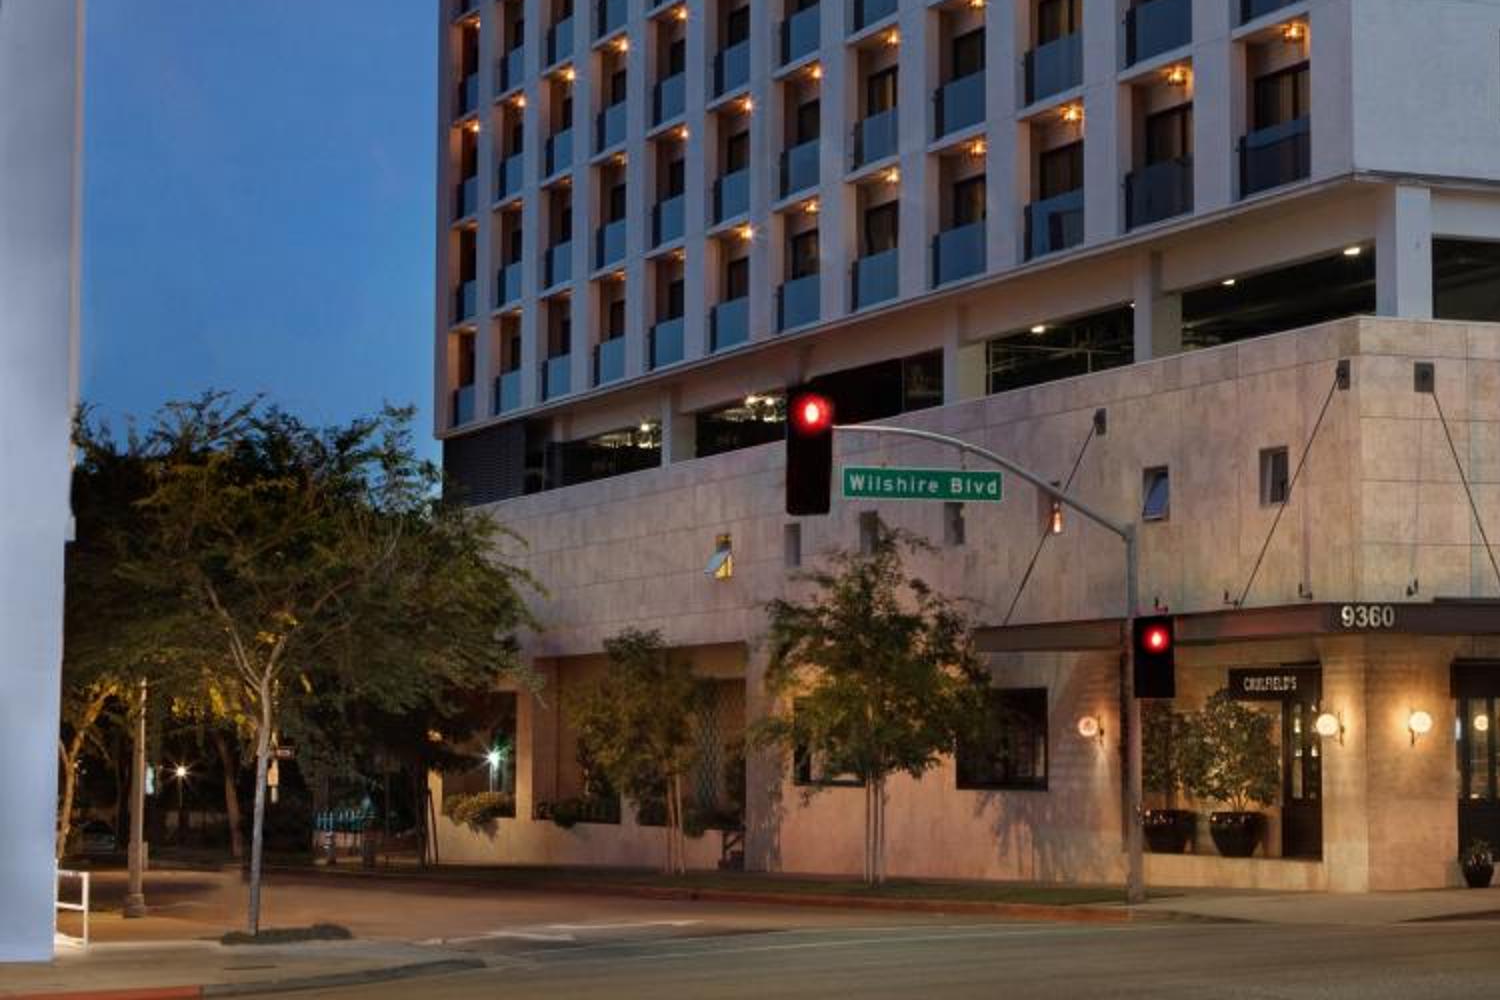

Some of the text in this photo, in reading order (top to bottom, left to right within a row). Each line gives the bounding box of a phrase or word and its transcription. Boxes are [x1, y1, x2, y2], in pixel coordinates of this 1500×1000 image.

[850, 475, 998, 495] Wilshire Blvd
[1341, 605, 1394, 627] 9360
